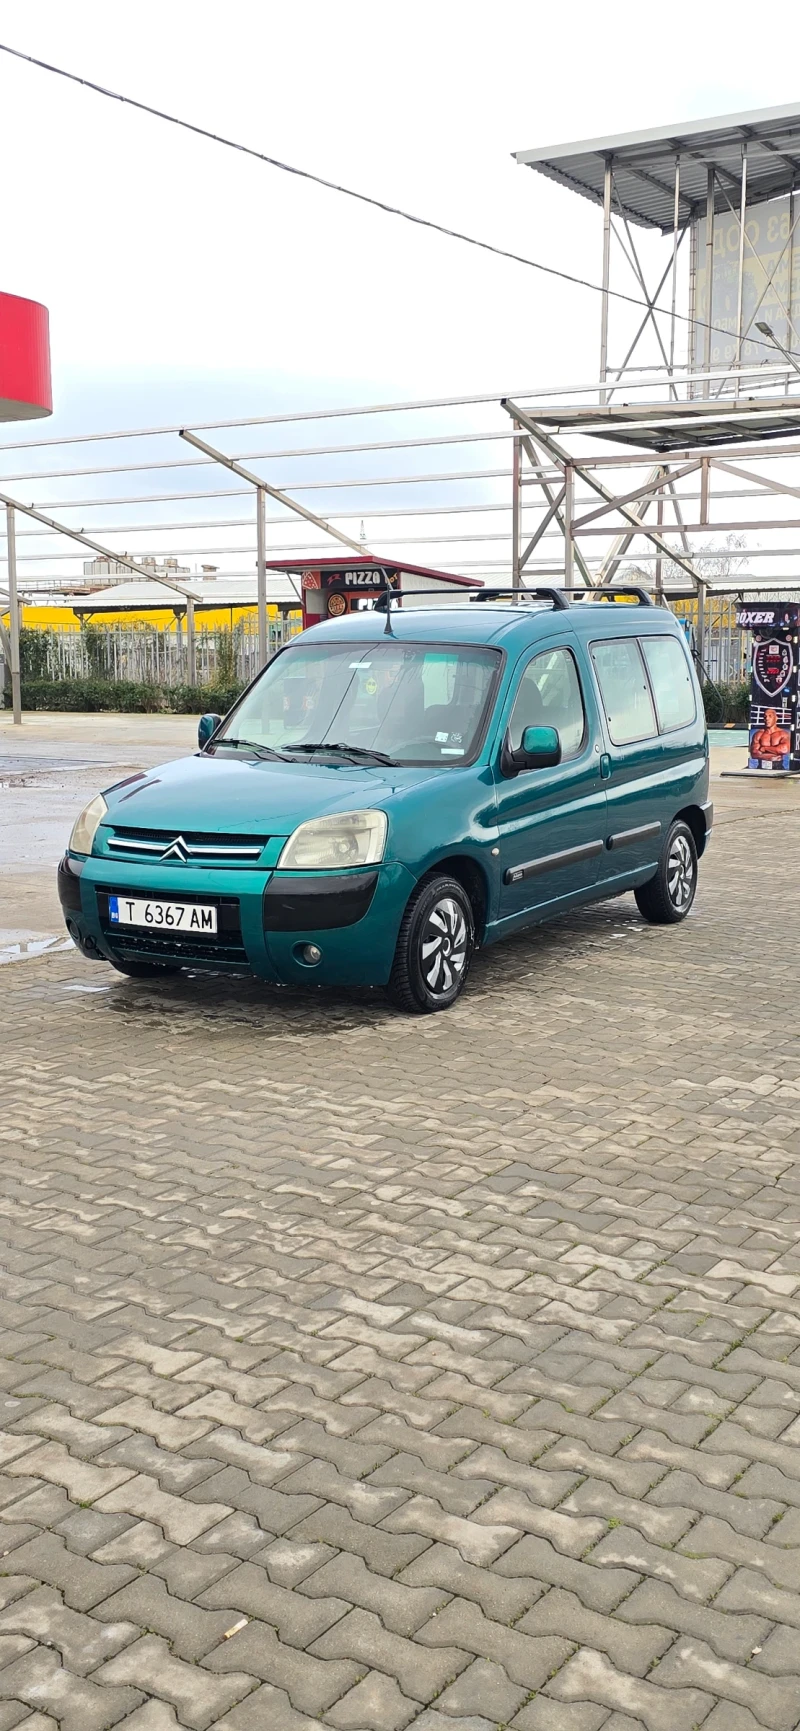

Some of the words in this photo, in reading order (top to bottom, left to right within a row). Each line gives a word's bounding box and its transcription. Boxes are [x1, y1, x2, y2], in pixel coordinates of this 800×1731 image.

[345, 571, 381, 585] PIZZA
[125, 901, 135, 921] T
[144, 903, 185, 926] 6367
[190, 908, 213, 929] AM
